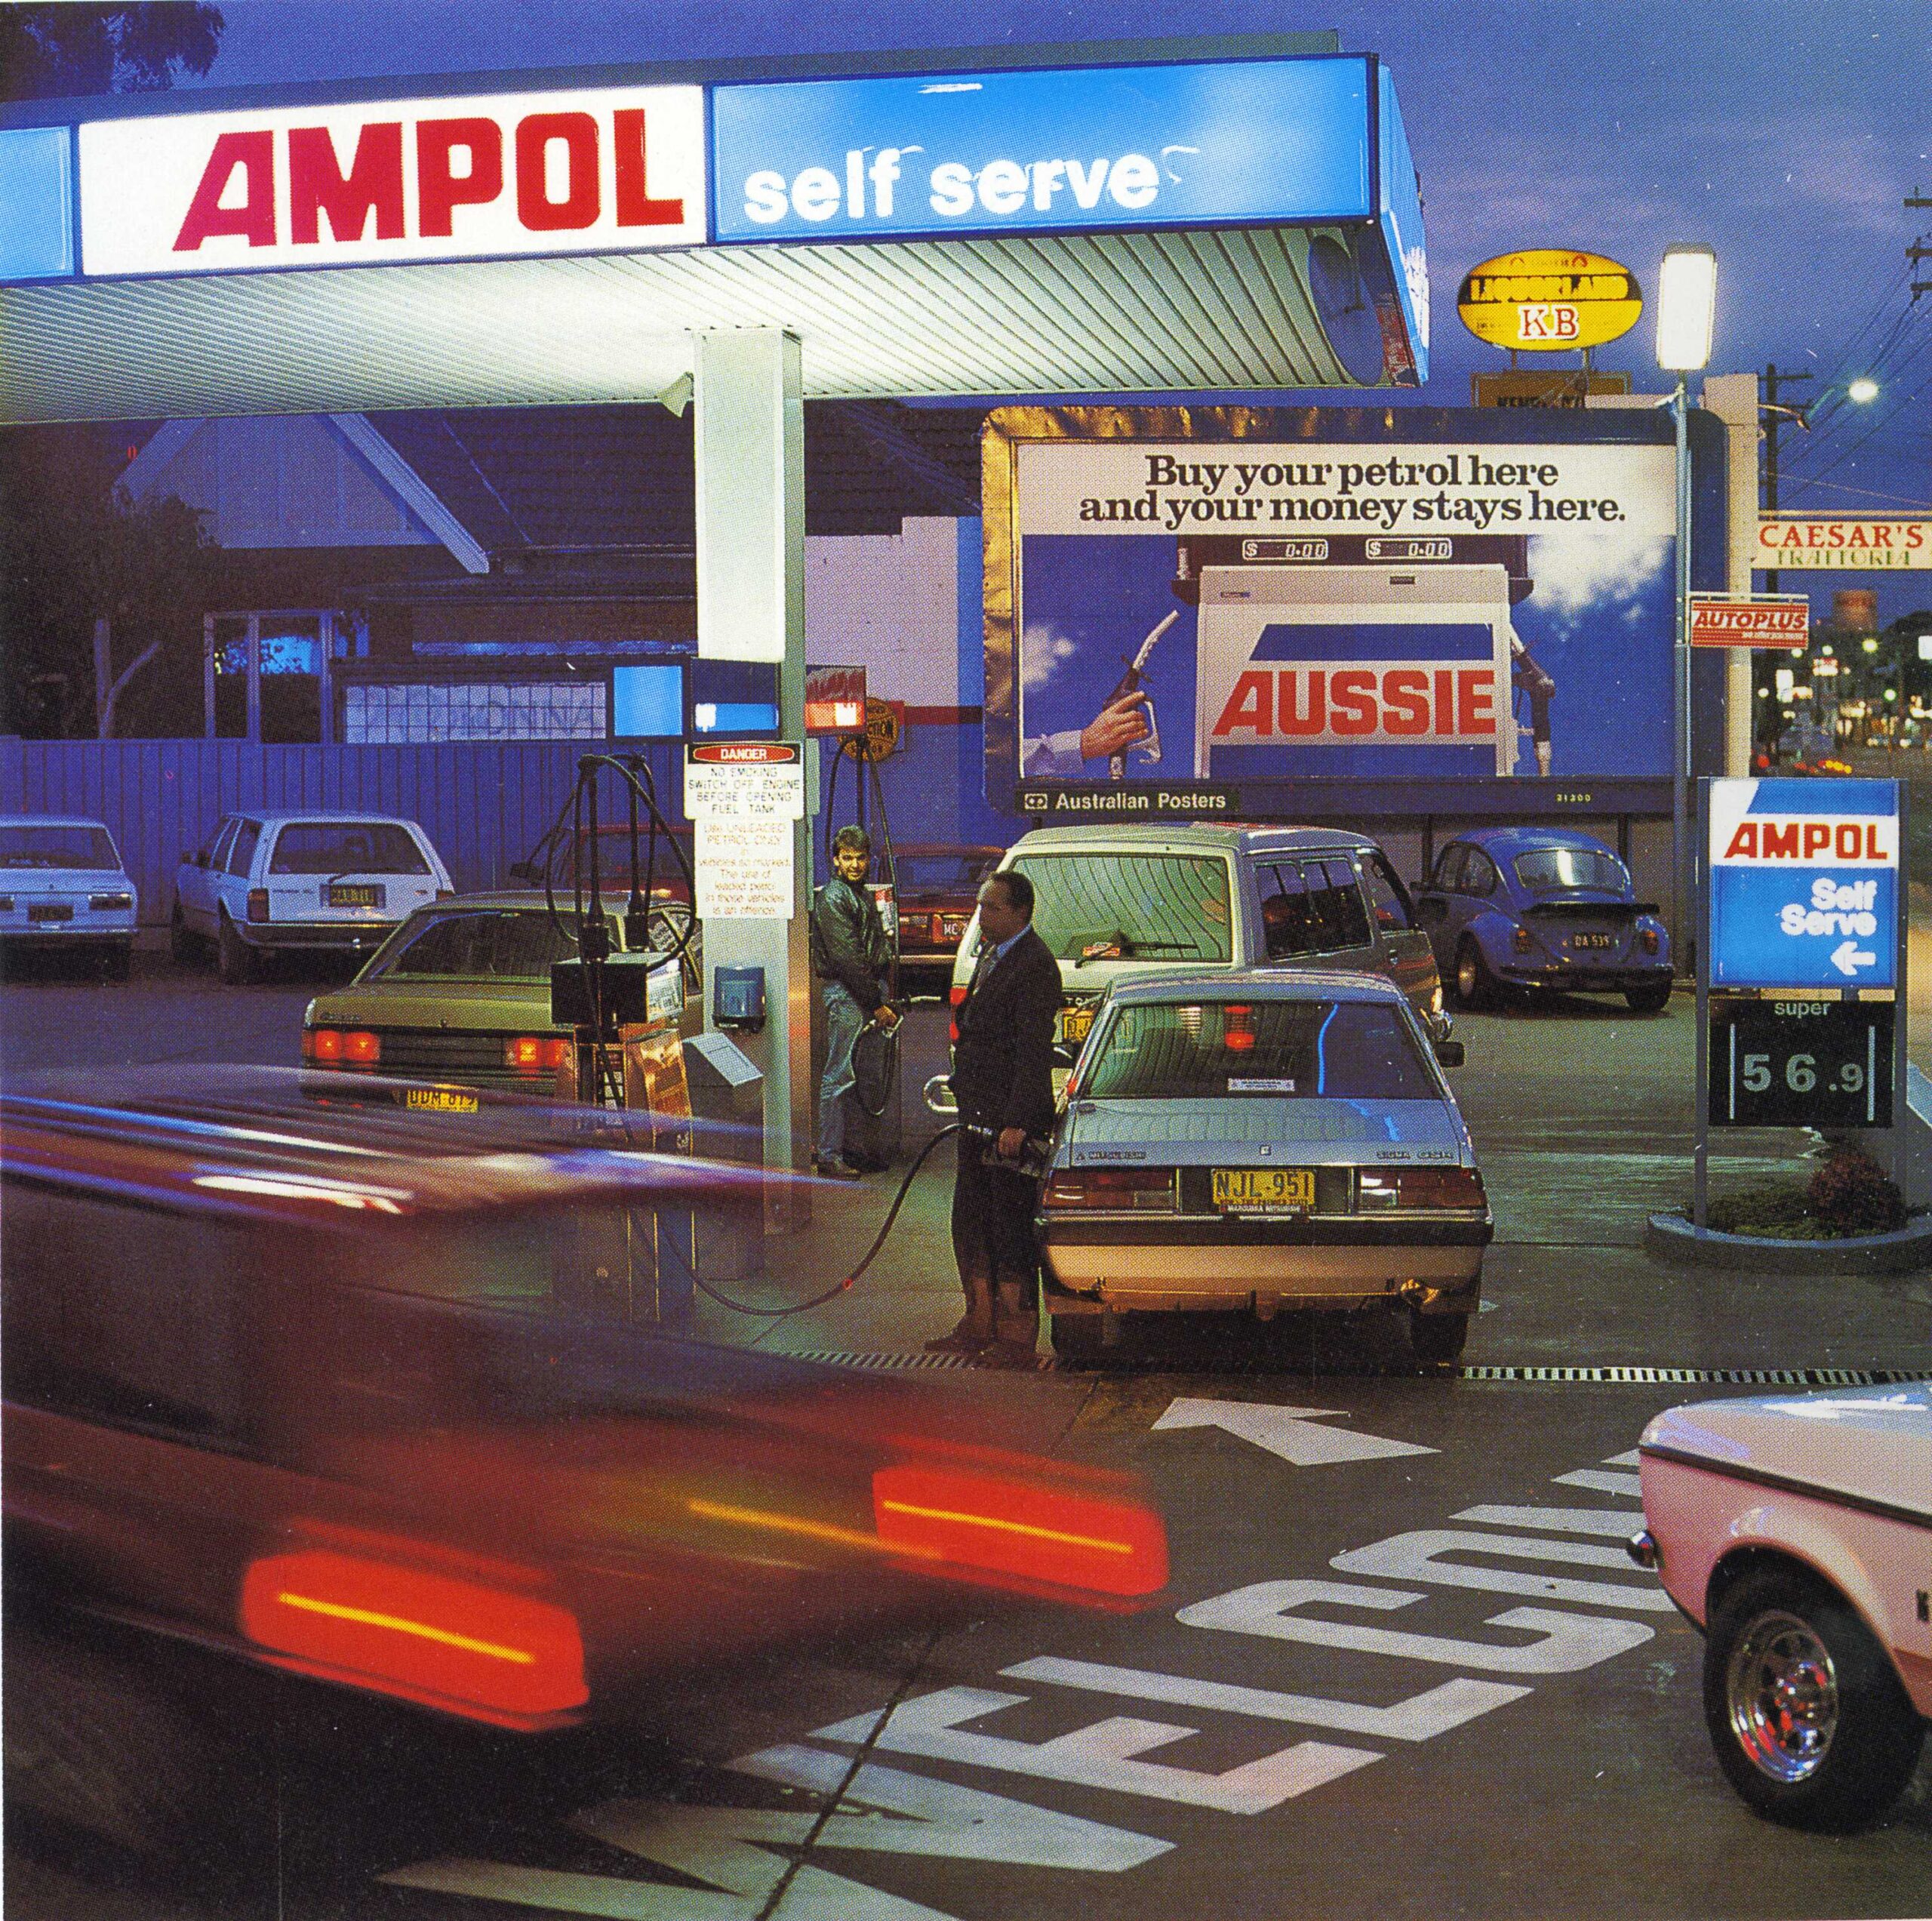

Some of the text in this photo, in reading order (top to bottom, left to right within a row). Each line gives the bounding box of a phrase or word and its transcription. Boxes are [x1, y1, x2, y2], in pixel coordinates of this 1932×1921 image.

[172, 109, 684, 251] AMPOL
[744, 148, 1160, 224] self serve
[1471, 276, 1629, 302] LIQUORLAND
[1521, 306, 1578, 337] KB
[1145, 454, 1558, 495] Buy your petrol here
[1080, 490, 1627, 528] and your money stays here.
[1758, 525, 1924, 548] CAESAR'S
[1245, 543, 1326, 558] $ 0.00
[1369, 542, 1448, 557] $ 0.00
[1777, 550, 1910, 565] TRATTORIA
[1695, 611, 1806, 629] AUTOPLUS
[1211, 670, 1496, 736] AUSSIE
[720, 748, 768, 760] DANGER
[710, 768, 777, 777] NO SMOKING
[688, 779, 800, 790] SWITCH OFF ENGINE
[697, 792, 792, 802] BEFORE OPENING
[1056, 790, 1226, 809] Australian Posters
[712, 804, 776, 814] FUEL TANK
[1724, 823, 1888, 859] AMPOL
[1811, 878, 1878, 911] Self
[1780, 904, 1878, 937] Serve
[1774, 1001, 1831, 1017] super
